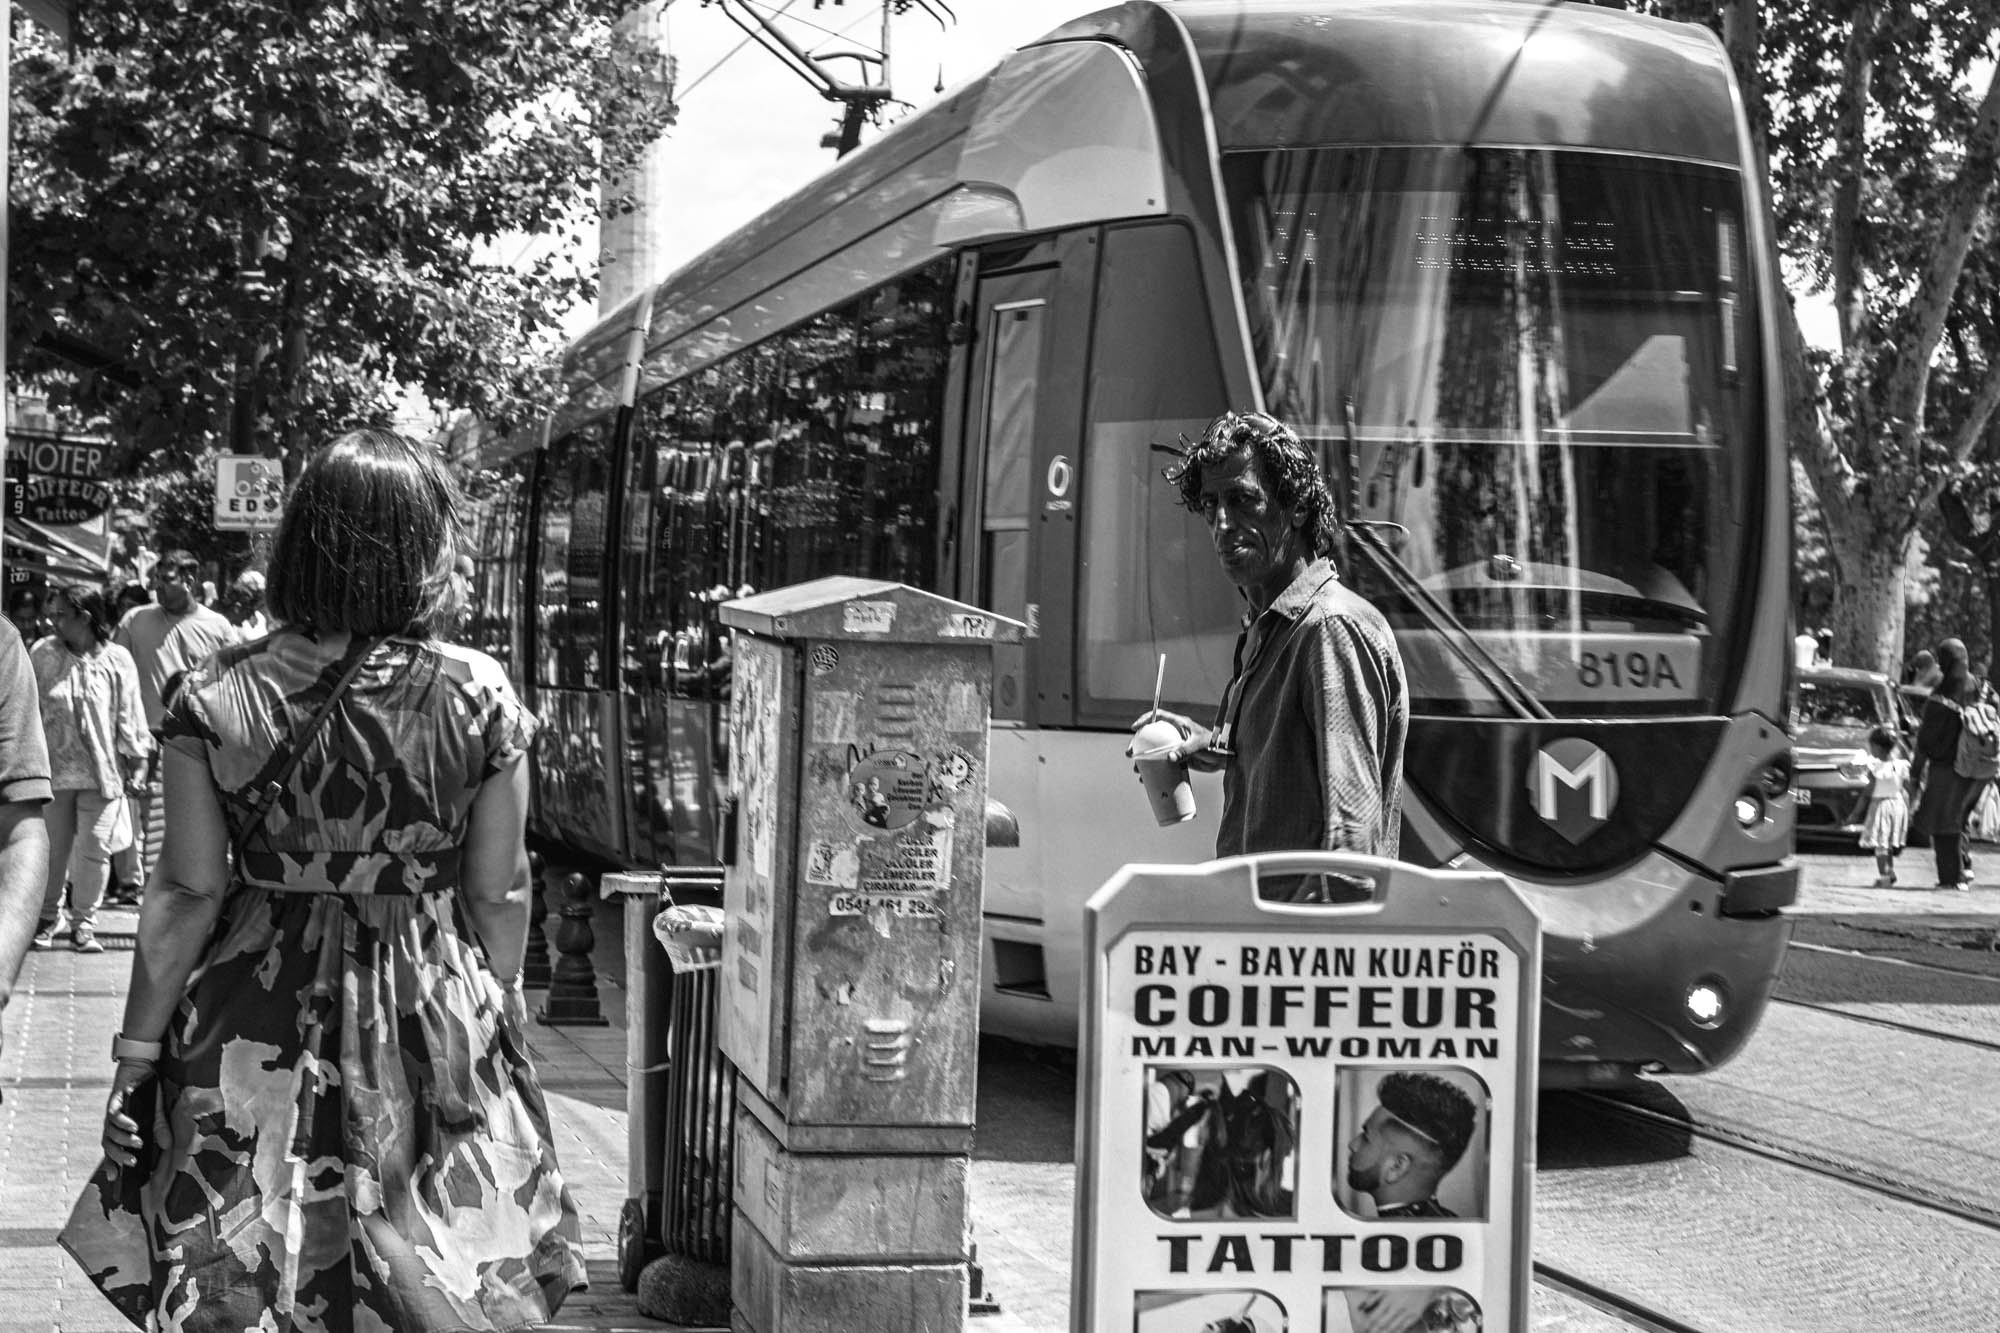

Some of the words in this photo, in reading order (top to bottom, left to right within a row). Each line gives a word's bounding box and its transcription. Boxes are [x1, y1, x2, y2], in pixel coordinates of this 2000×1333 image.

[27, 479, 107, 508] OIFFEUR
[1579, 652, 1683, 690] 819A
[1538, 749, 1608, 821] M
[1134, 945, 1202, 976] BAY
[1215, 959, 1227, 967] -
[1240, 946, 1355, 978] BAYAN
[1369, 942, 1500, 979] KUAFÖR
[1133, 983, 1498, 1029] COIFFEUR
[1131, 1036, 1499, 1059] MAN-WOMAN
[1156, 1234, 1464, 1273] TATTOO
